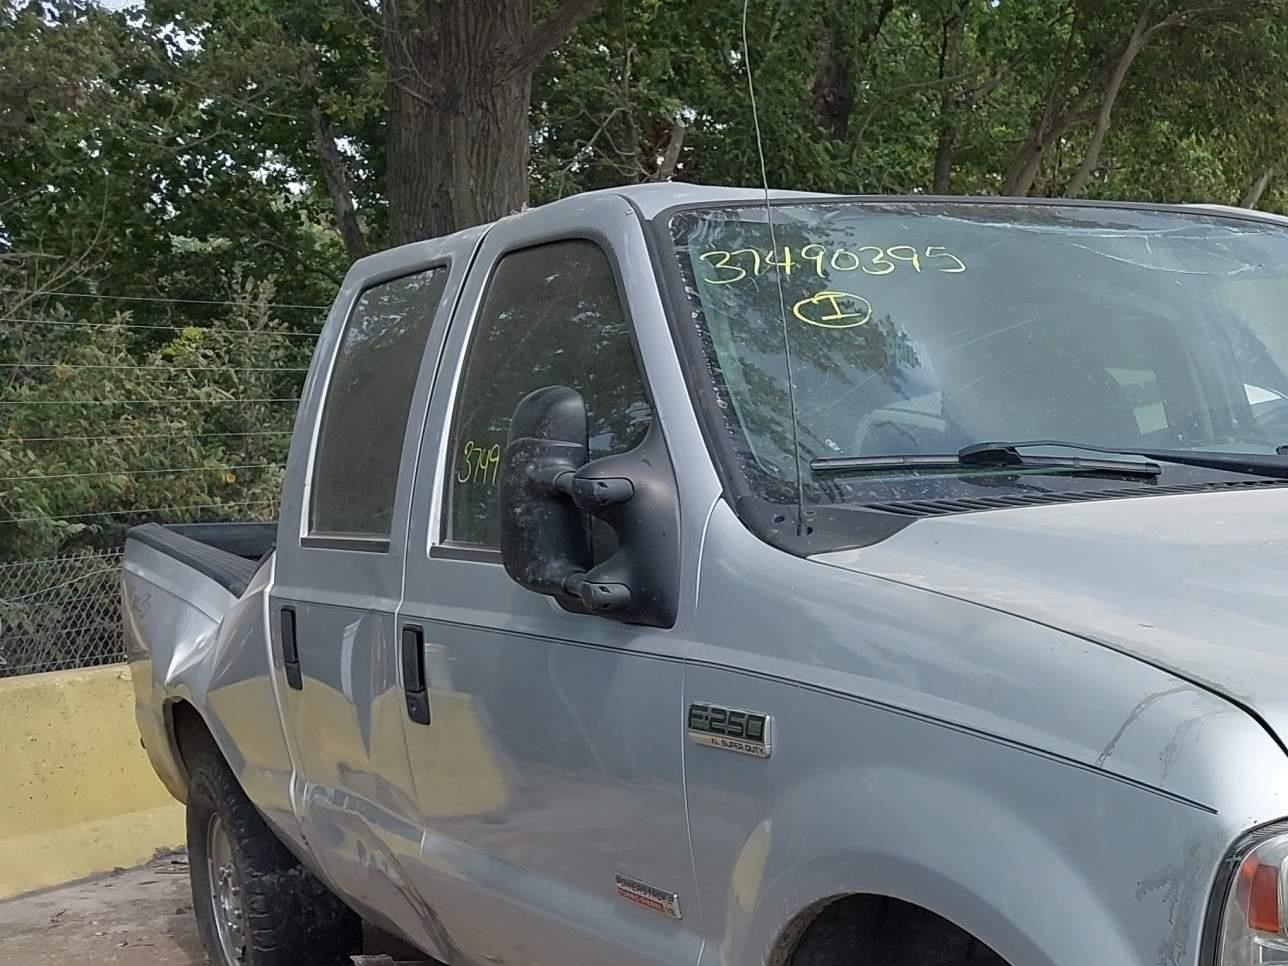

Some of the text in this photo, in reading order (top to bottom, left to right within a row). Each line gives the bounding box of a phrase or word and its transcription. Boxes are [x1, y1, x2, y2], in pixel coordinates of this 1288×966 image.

[699, 244, 967, 285] 37490395
[687, 704, 766, 743] F-250
[721, 740, 744, 751] SUPER
[744, 743, 764, 755] DUTY
